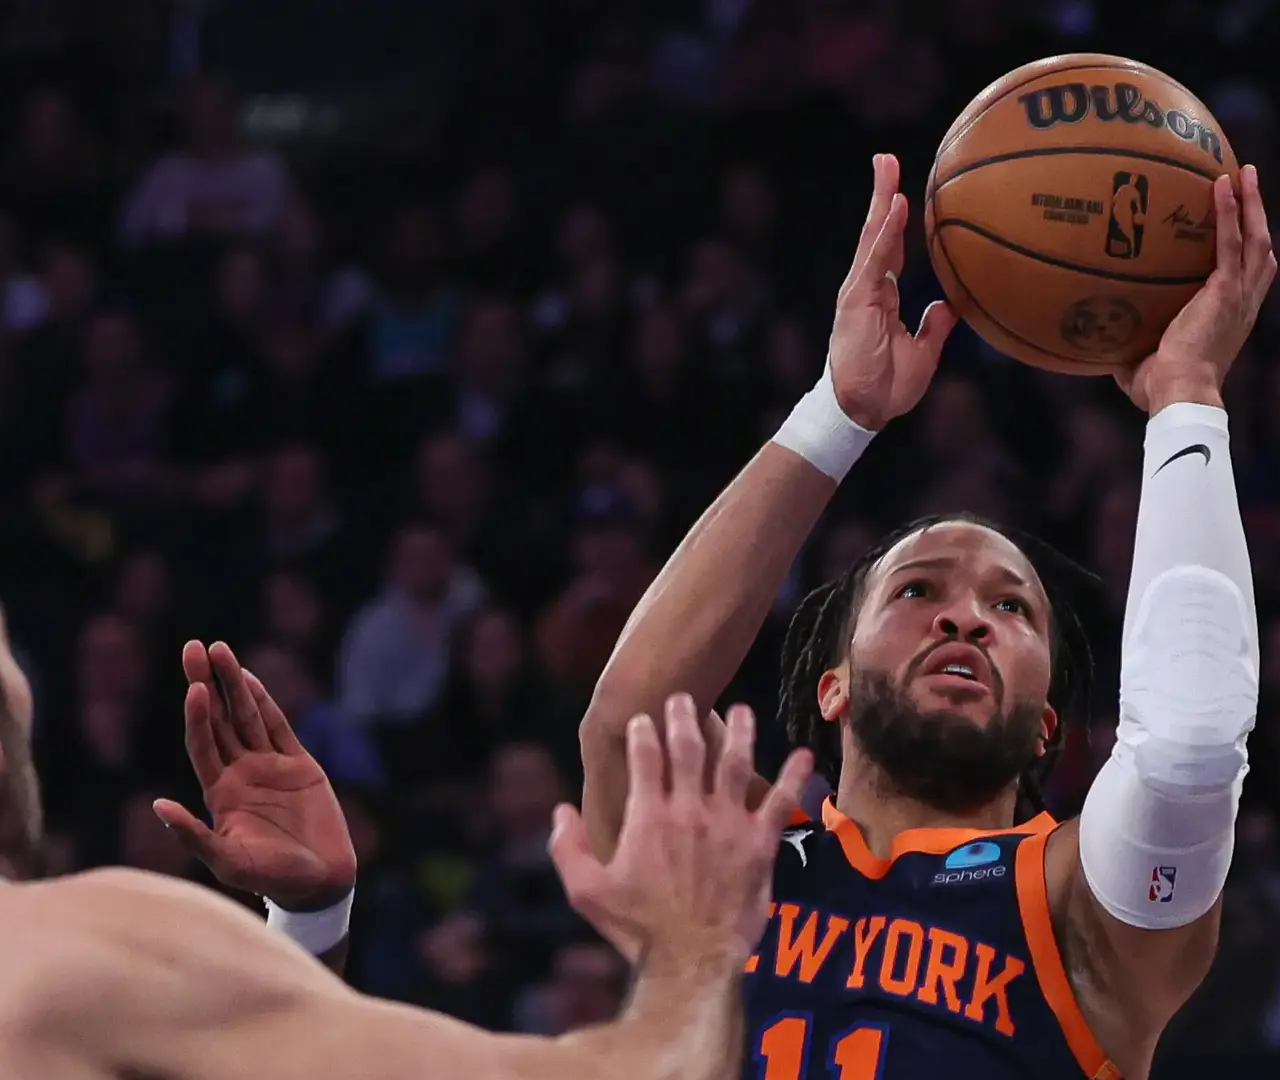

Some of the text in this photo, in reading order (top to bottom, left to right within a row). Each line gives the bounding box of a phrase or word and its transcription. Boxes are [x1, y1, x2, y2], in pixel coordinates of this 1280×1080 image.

[1018, 82, 1224, 165] Wilson
[934, 865, 1006, 884] sphere
[845, 916, 1026, 1037] YORK
